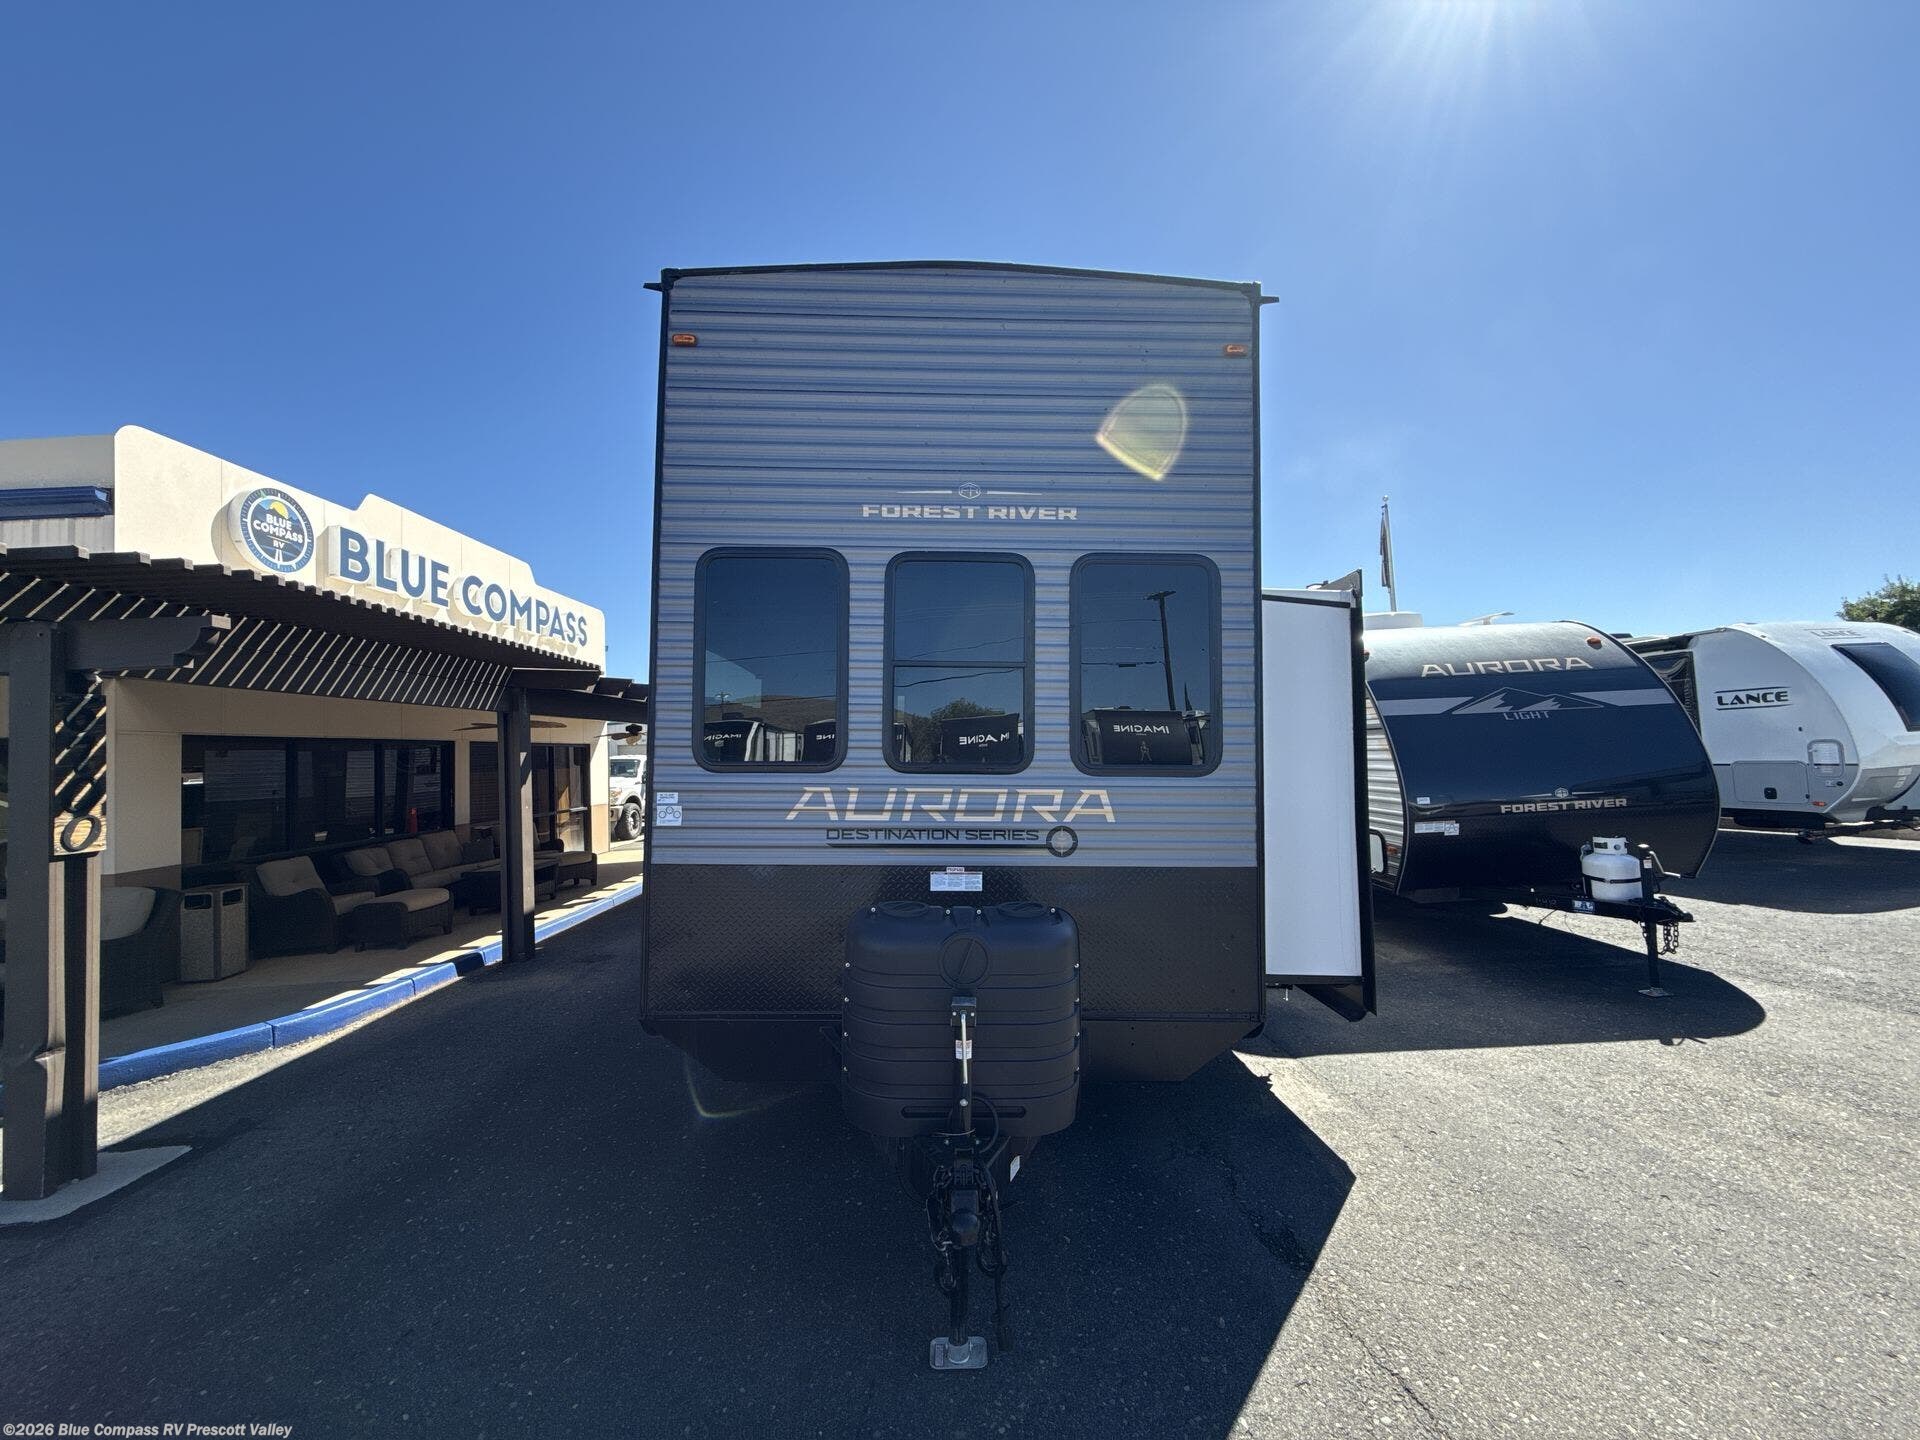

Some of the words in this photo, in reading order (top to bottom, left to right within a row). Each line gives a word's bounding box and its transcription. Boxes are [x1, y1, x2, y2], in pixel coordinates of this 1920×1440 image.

[861, 504, 980, 519] FOREST
[988, 506, 1078, 520] RIVER
[266, 513, 292, 531] BLUE
[253, 519, 303, 543] COMPASS
[273, 540, 285, 549] RV
[339, 526, 449, 607] BLUE
[462, 575, 588, 647] COMPASS
[1421, 657, 1593, 678] AURORA
[1717, 691, 1789, 706] LANCE
[1503, 710, 1551, 721] LIGHT
[784, 786, 1116, 823] AURORA
[1500, 801, 1568, 814] FOREST
[1575, 798, 1628, 809] RIVER
[826, 828, 959, 841] DESTINATION
[965, 829, 1039, 841] SERIES
